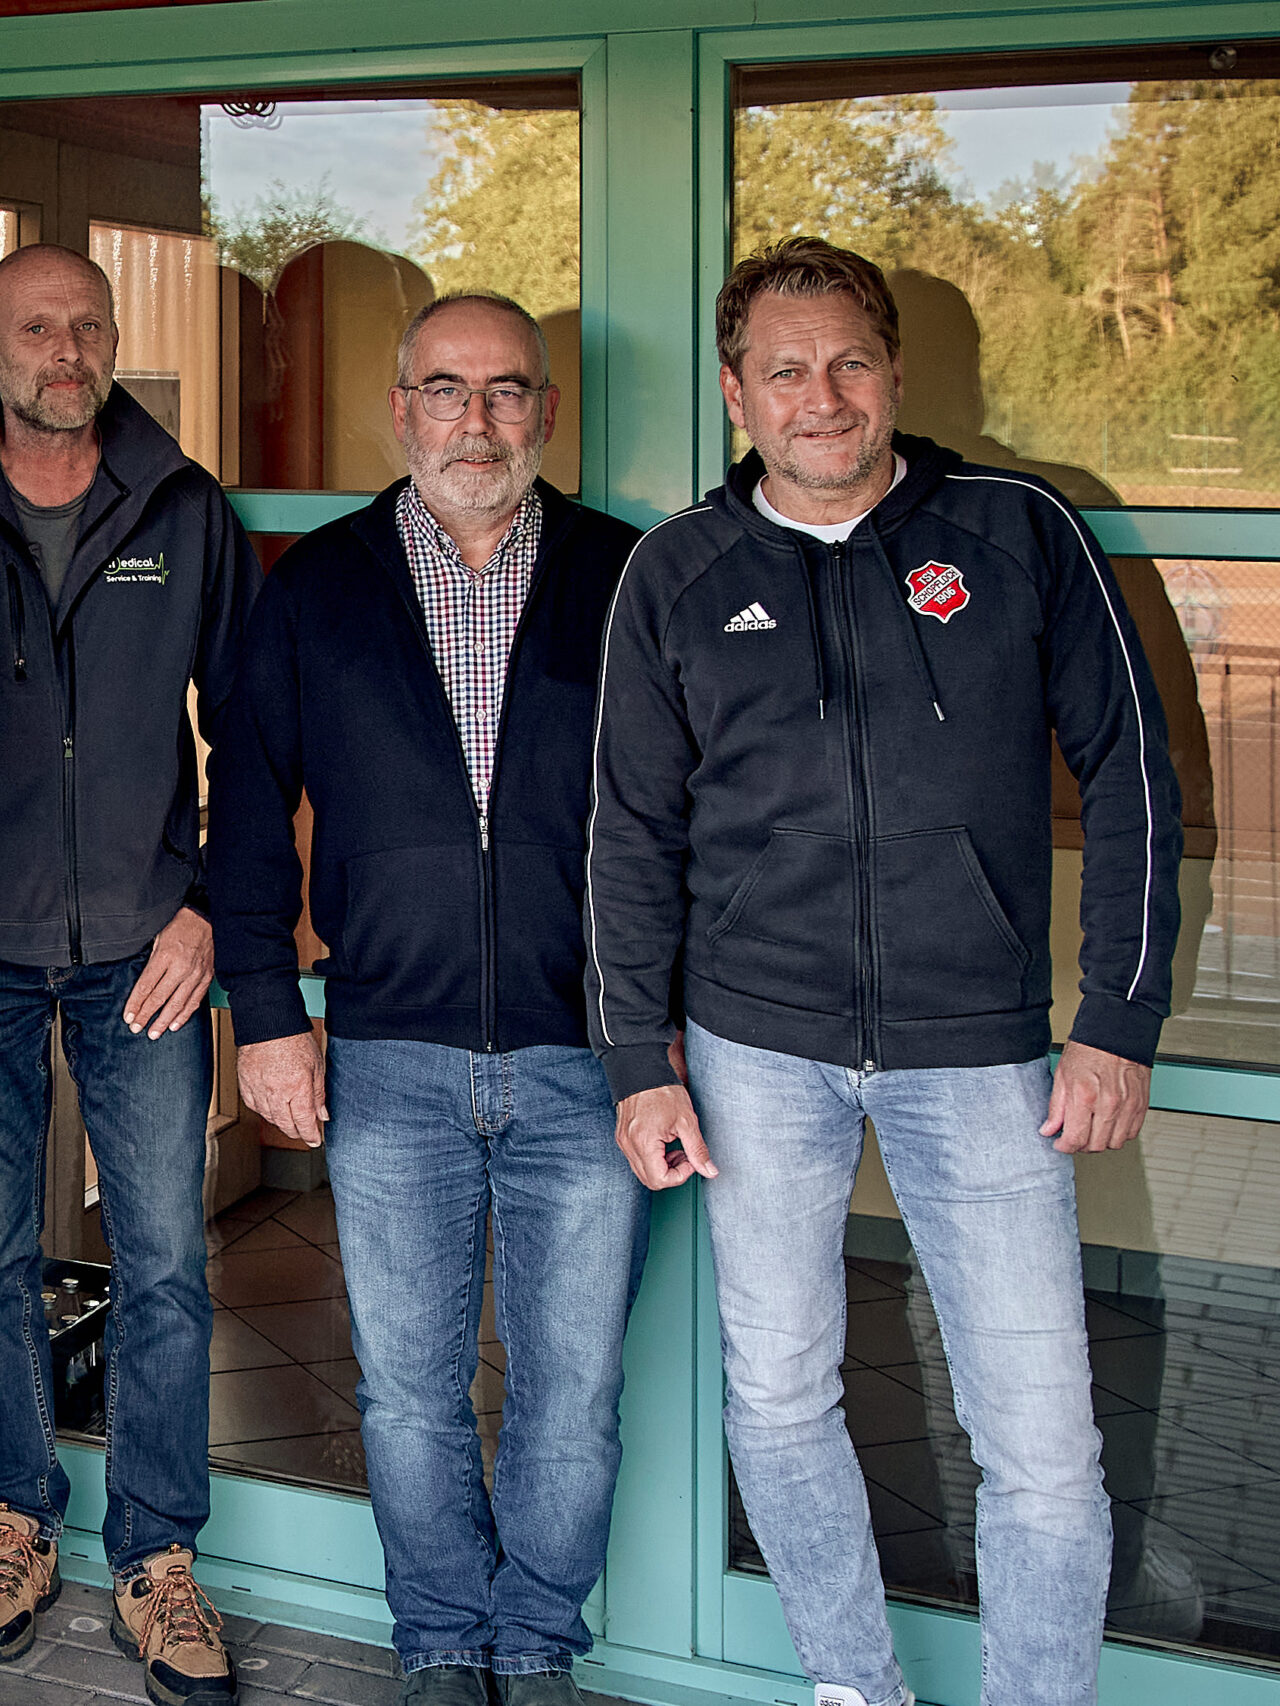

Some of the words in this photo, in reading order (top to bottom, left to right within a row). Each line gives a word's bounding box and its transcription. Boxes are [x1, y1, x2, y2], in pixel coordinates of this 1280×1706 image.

[106, 575, 131, 583] Service
[138, 574, 162, 583] Training
[917, 568, 937, 585] TSV
[913, 569, 958, 606] SCHOPFLOCH
[933, 586, 957, 605] 1906
[723, 619, 777, 632] adidas
